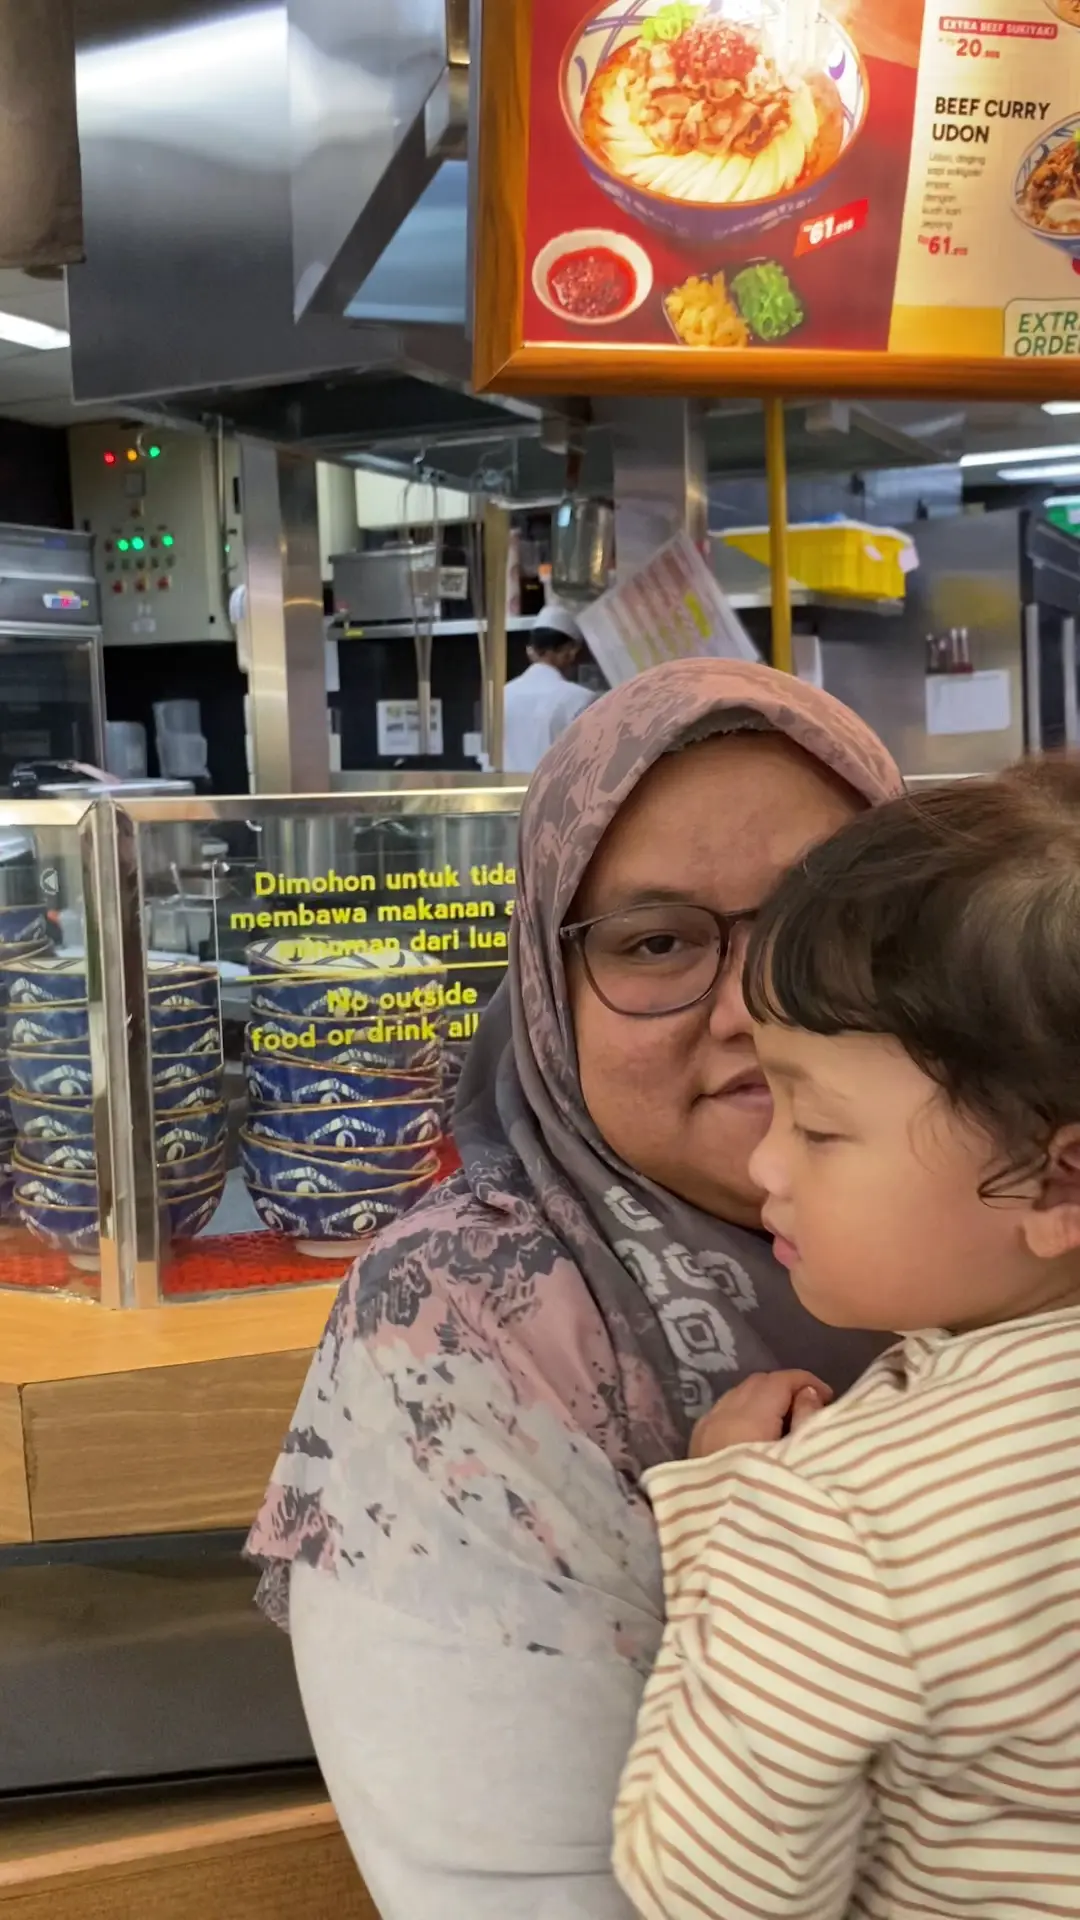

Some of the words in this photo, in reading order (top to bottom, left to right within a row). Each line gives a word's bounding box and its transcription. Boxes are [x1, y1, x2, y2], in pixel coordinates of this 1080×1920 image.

[943, 18, 977, 31] EXTRA
[980, 21, 1004, 33] BEEF
[1006, 23, 1054, 36] SUKIYAKI
[935, 96, 981, 117] BEEF
[985, 99, 1051, 120] CURRY
[932, 123, 990, 144] UDON
[1018, 311, 1080, 333] EXTR
[1014, 334, 1080, 357] ORDE
[255, 869, 375, 897] Dimohon
[386, 865, 461, 890] untuk
[469, 863, 516, 887] tida
[230, 903, 367, 930] membawa
[377, 897, 495, 922] makanan
[410, 929, 459, 952] dari
[469, 926, 510, 950] lua
[327, 988, 368, 1014] No
[379, 981, 478, 1010] outside
[251, 1023, 316, 1051] food
[328, 1027, 355, 1047] or
[367, 1016, 436, 1044] drink
